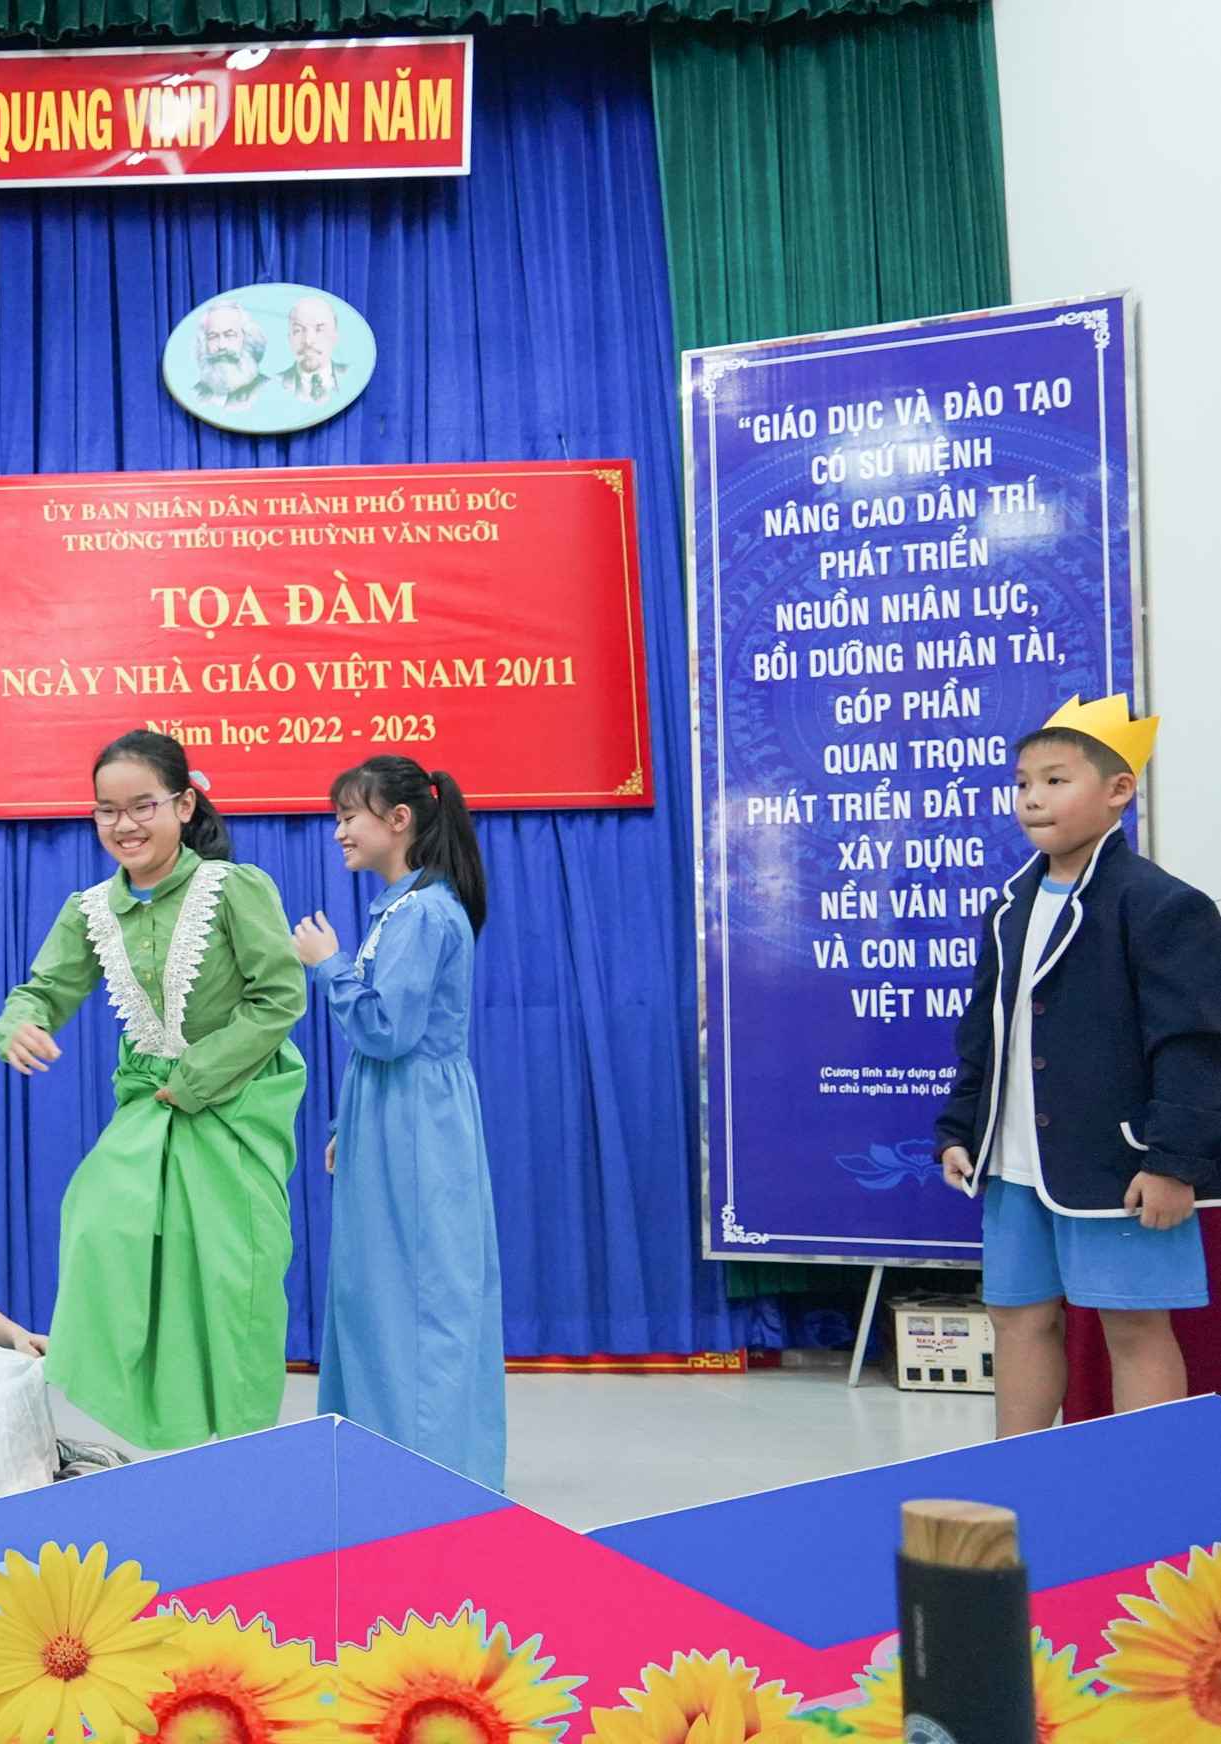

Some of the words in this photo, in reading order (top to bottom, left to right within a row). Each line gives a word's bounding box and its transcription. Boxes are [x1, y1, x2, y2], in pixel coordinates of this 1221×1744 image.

[124, 84, 216, 149] VINH
[234, 65, 350, 145] MUÔN
[364, 67, 453, 142] NĂM
[828, 400, 884, 437] DỤC
[895, 387, 932, 426] VÀ
[944, 381, 1003, 421] ĐÀO
[1014, 377, 1072, 417] TẠO
[811, 447, 846, 486] CÓ
[859, 441, 897, 481] SỨ
[907, 437, 993, 478] MỆNH
[43, 499, 75, 522] ỦY
[82, 502, 129, 521] BAN
[135, 496, 203, 519] NHÂN
[209, 494, 258, 517] DÂN
[264, 492, 349, 515] THÀNH
[355, 487, 405, 513] PHỐ
[410, 488, 460, 512] THỦ
[466, 487, 517, 511] ĐỨC
[764, 498, 840, 538] NÂNG
[851, 495, 906, 528] CAO
[917, 487, 977, 525] DÂN
[988, 474, 1046, 517] TRÍ,
[62, 528, 164, 552] TRƯỜNG
[169, 523, 225, 549] TIỂU
[231, 528, 284, 551] HỌC
[290, 523, 375, 546] HUỲNH
[381, 522, 431, 544] VĂN
[820, 541, 892, 581] PHÁT
[903, 526, 989, 572] TRIỂN
[150, 583, 270, 641] TỌA
[284, 570, 417, 627] ĐÀM
[776, 584, 869, 632] NGUỒN
[882, 584, 960, 624] NHÂN
[973, 580, 1039, 621] LỰC,
[1, 661, 107, 698] NGÀY
[114, 656, 193, 696] NHÀ
[201, 654, 296, 693] GIÁO
[308, 652, 392, 698] VIỆT
[400, 659, 487, 690] NAM
[494, 656, 576, 687] 20/11
[754, 640, 797, 682] BỒI
[809, 639, 903, 678] DƯỠNG
[917, 631, 996, 671] NHÂN
[1008, 626, 1066, 666] TÀI,
[835, 687, 891, 726] GÓP
[903, 677, 980, 721] PHẦN
[146, 719, 212, 746] Năm
[221, 718, 270, 752] học
[278, 716, 343, 744] 2022
[370, 714, 436, 742] 2023
[824, 742, 897, 775] QUAN
[909, 736, 1007, 773] TRỌNG
[748, 788, 817, 826] PHÁT
[828, 777, 911, 822] TRIỂN
[924, 777, 981, 819] ĐẤT
[838, 834, 893, 871] XÂY
[905, 834, 985, 873] DỰNG
[821, 880, 878, 920] NỀN
[890, 883, 947, 918] VĂN
[813, 933, 849, 969] VÀ
[861, 938, 916, 969] CON
[851, 981, 914, 1024] VIỆT
[926, 988, 973, 1019] NA
